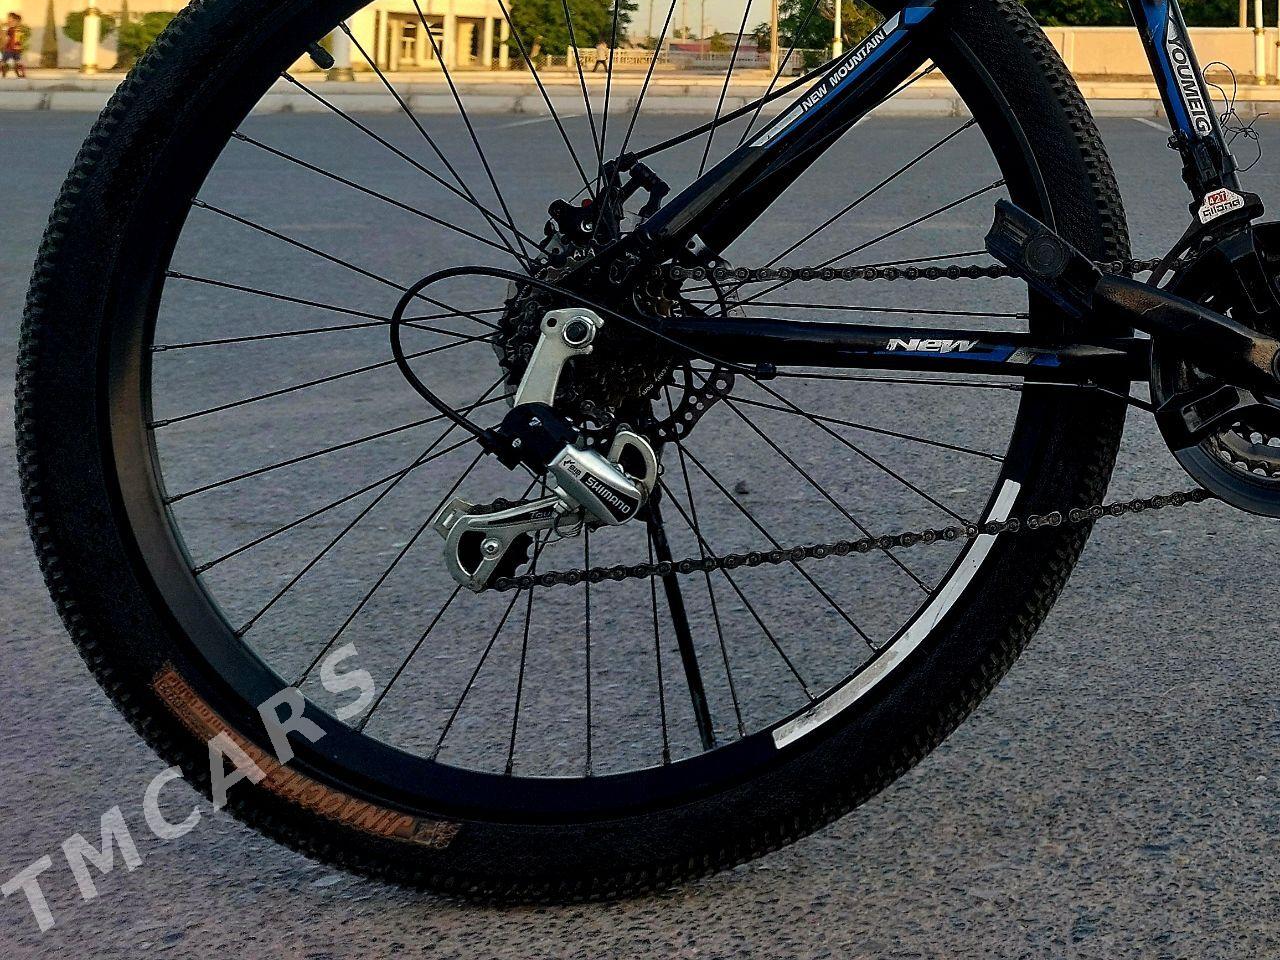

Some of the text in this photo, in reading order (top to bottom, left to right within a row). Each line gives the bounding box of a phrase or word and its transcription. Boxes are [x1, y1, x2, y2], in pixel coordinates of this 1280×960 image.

[802, 28, 887, 112] NEW MOUNTAIN
[1168, 36, 1211, 132] YOUMEIG
[585, 476, 631, 514] SHIMANO
